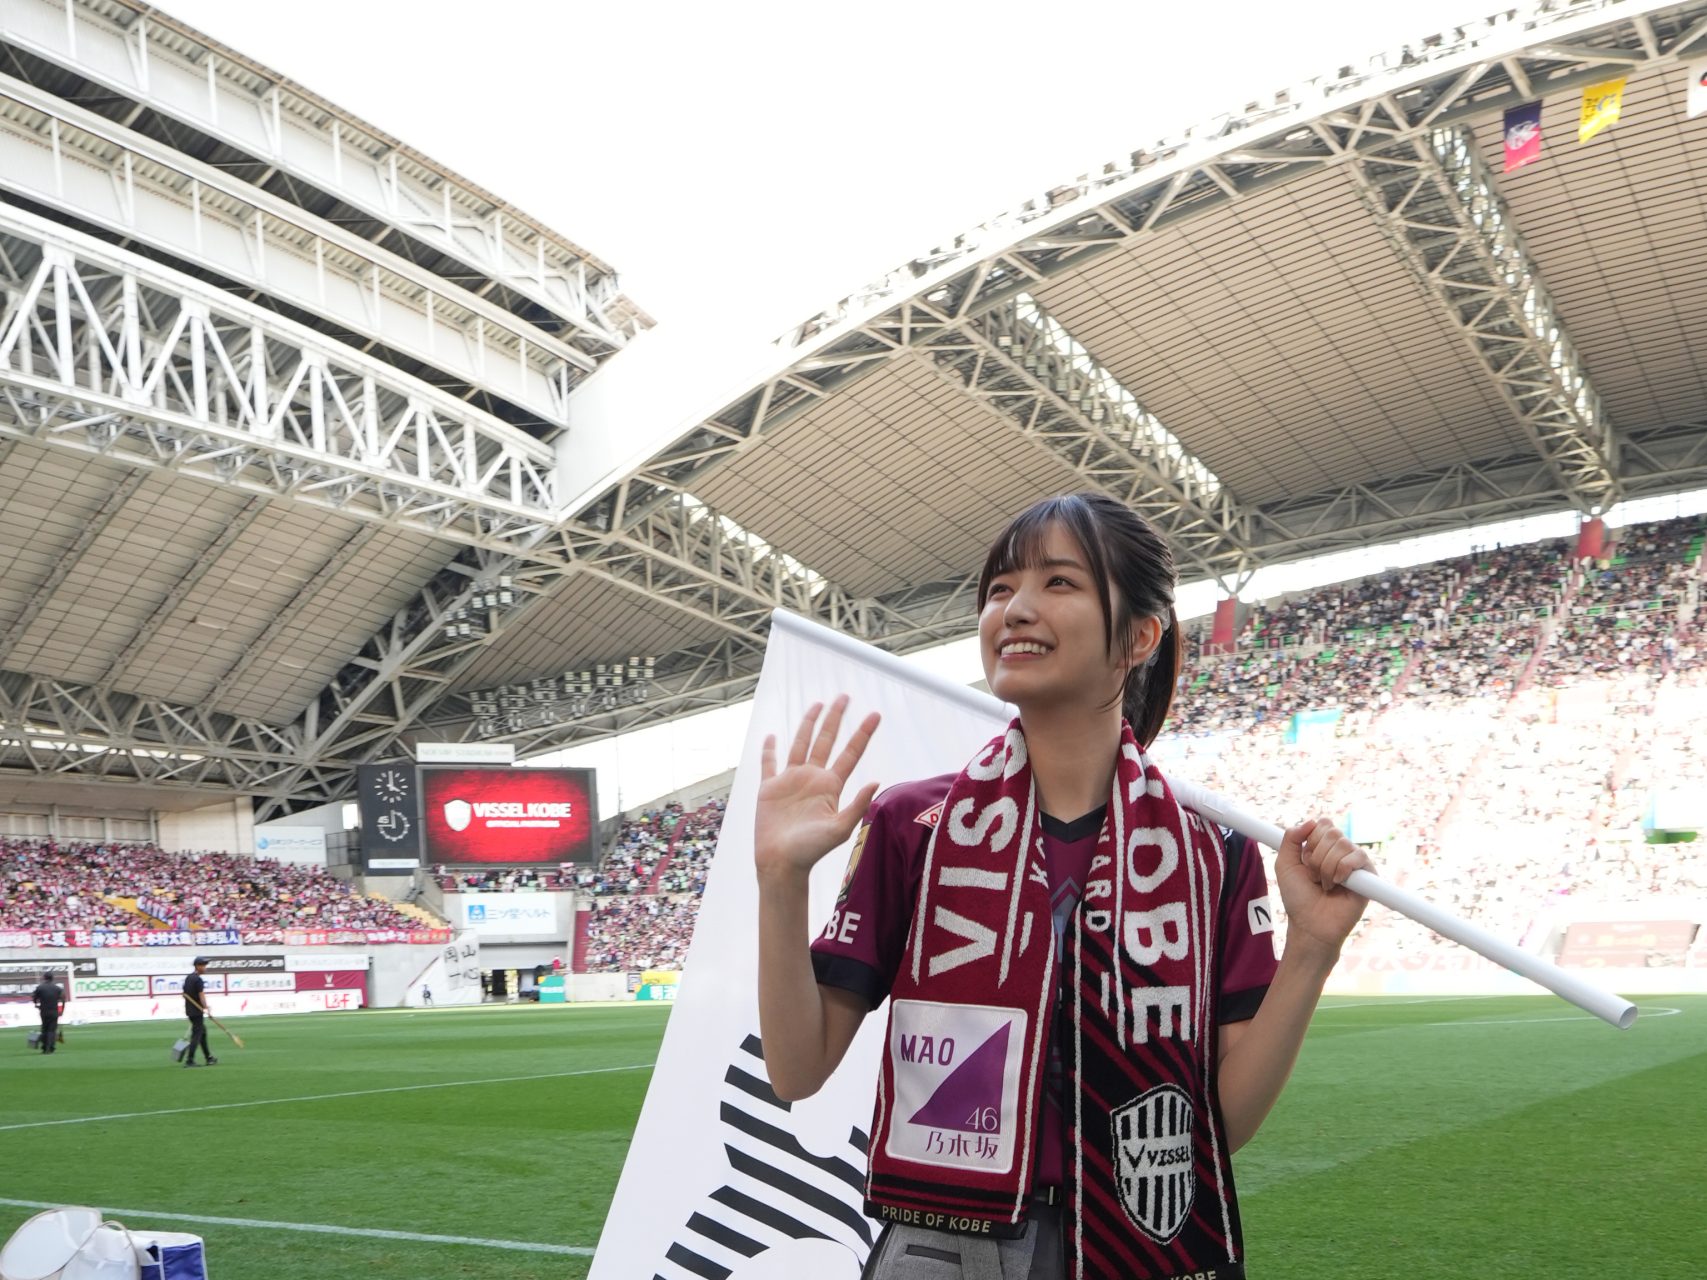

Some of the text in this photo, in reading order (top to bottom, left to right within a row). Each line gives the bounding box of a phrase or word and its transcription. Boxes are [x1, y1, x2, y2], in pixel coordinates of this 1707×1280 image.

[473, 802, 572, 818] VISSEL KOBE
[444, 944, 477, 964] 岡山
[75, 979, 145, 993] MORESCO
[901, 1034, 955, 1066] MAO
[965, 1106, 998, 1131] 46
[926, 1130, 1000, 1160] 乃木坂
[882, 1205, 991, 1233] PRIDE OF KOBE
